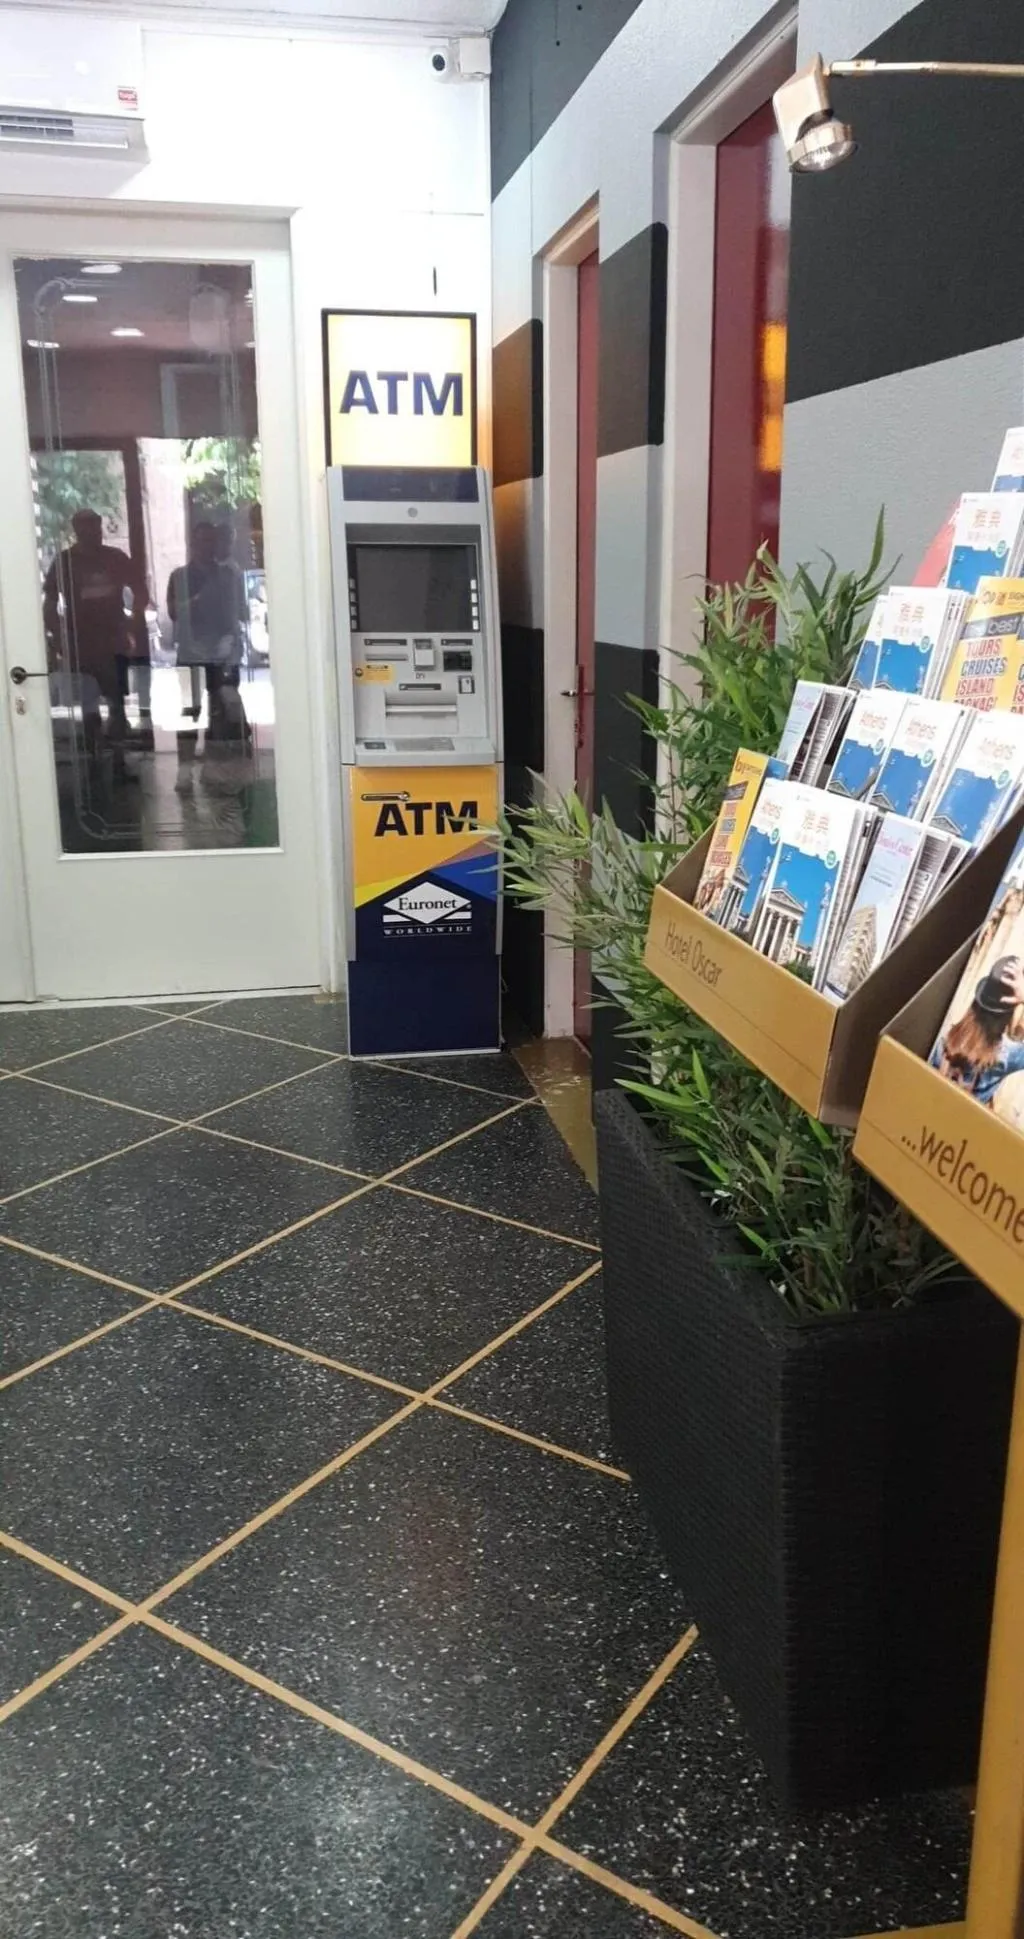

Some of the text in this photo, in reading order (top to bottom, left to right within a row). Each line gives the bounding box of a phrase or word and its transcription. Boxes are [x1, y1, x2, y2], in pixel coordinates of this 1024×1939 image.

[339, 369, 463, 416] ATM
[966, 639, 1002, 657] TOURS
[961, 657, 1008, 677] CRUISES
[955, 677, 995, 696] ISLAND
[374, 801, 478, 837] ATM
[398, 896, 457, 911] Euronet
[383, 926, 472, 936] WORLDWIDE
[664, 920, 722, 988] Hotel Oscar
